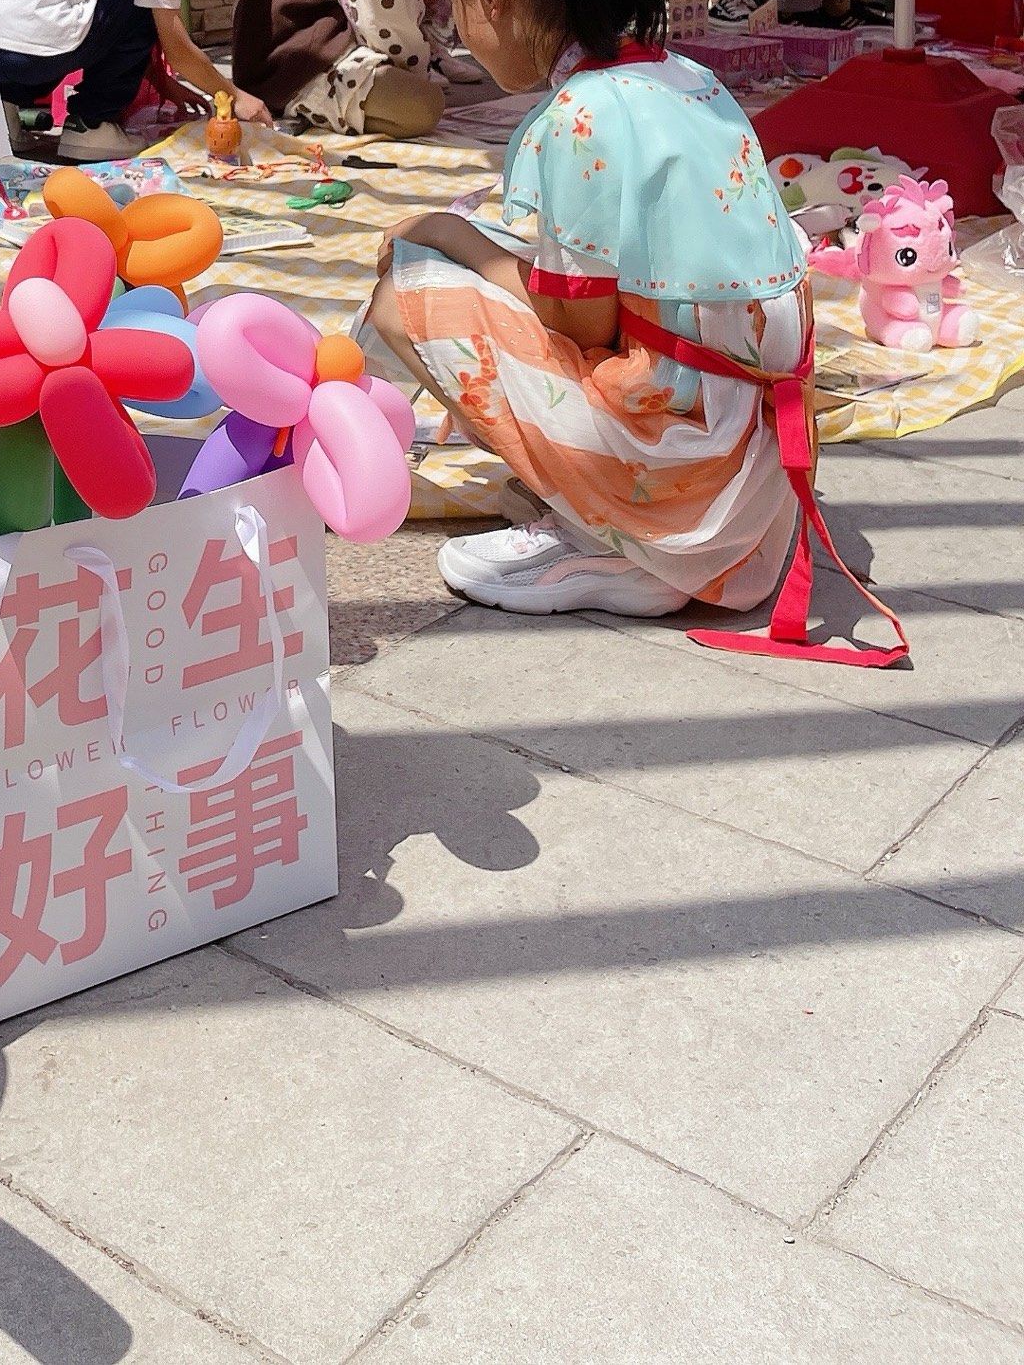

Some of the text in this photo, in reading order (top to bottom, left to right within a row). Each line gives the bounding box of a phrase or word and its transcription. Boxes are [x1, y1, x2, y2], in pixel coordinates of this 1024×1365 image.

[144, 552, 168, 686] GOOD
[171, 678, 302, 738] FLOWR
[145, 784, 168, 933] THING
